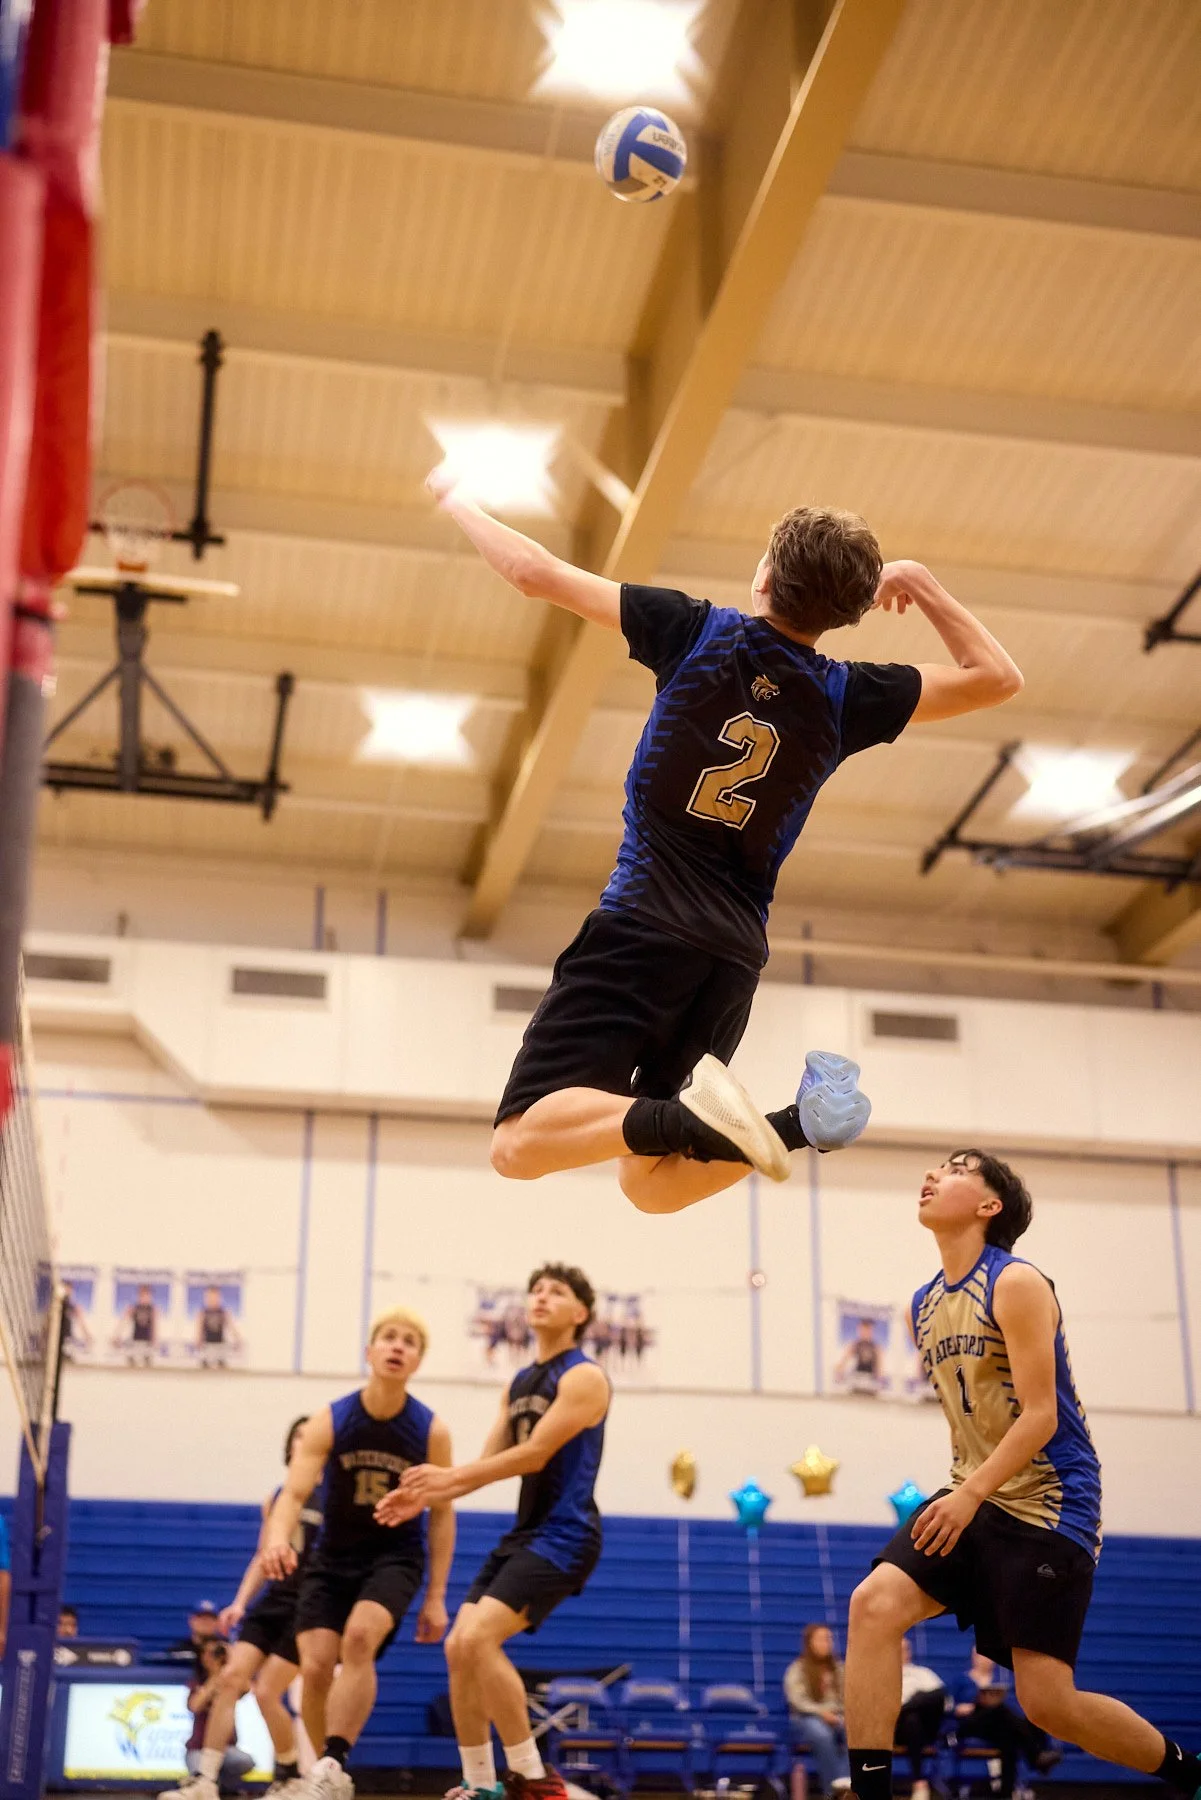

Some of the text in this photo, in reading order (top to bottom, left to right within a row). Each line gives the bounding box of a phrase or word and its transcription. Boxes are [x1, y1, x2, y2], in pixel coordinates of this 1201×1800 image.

[686, 711, 781, 830] 2
[954, 1364, 974, 1416] 1
[353, 1470, 389, 1505] 15
